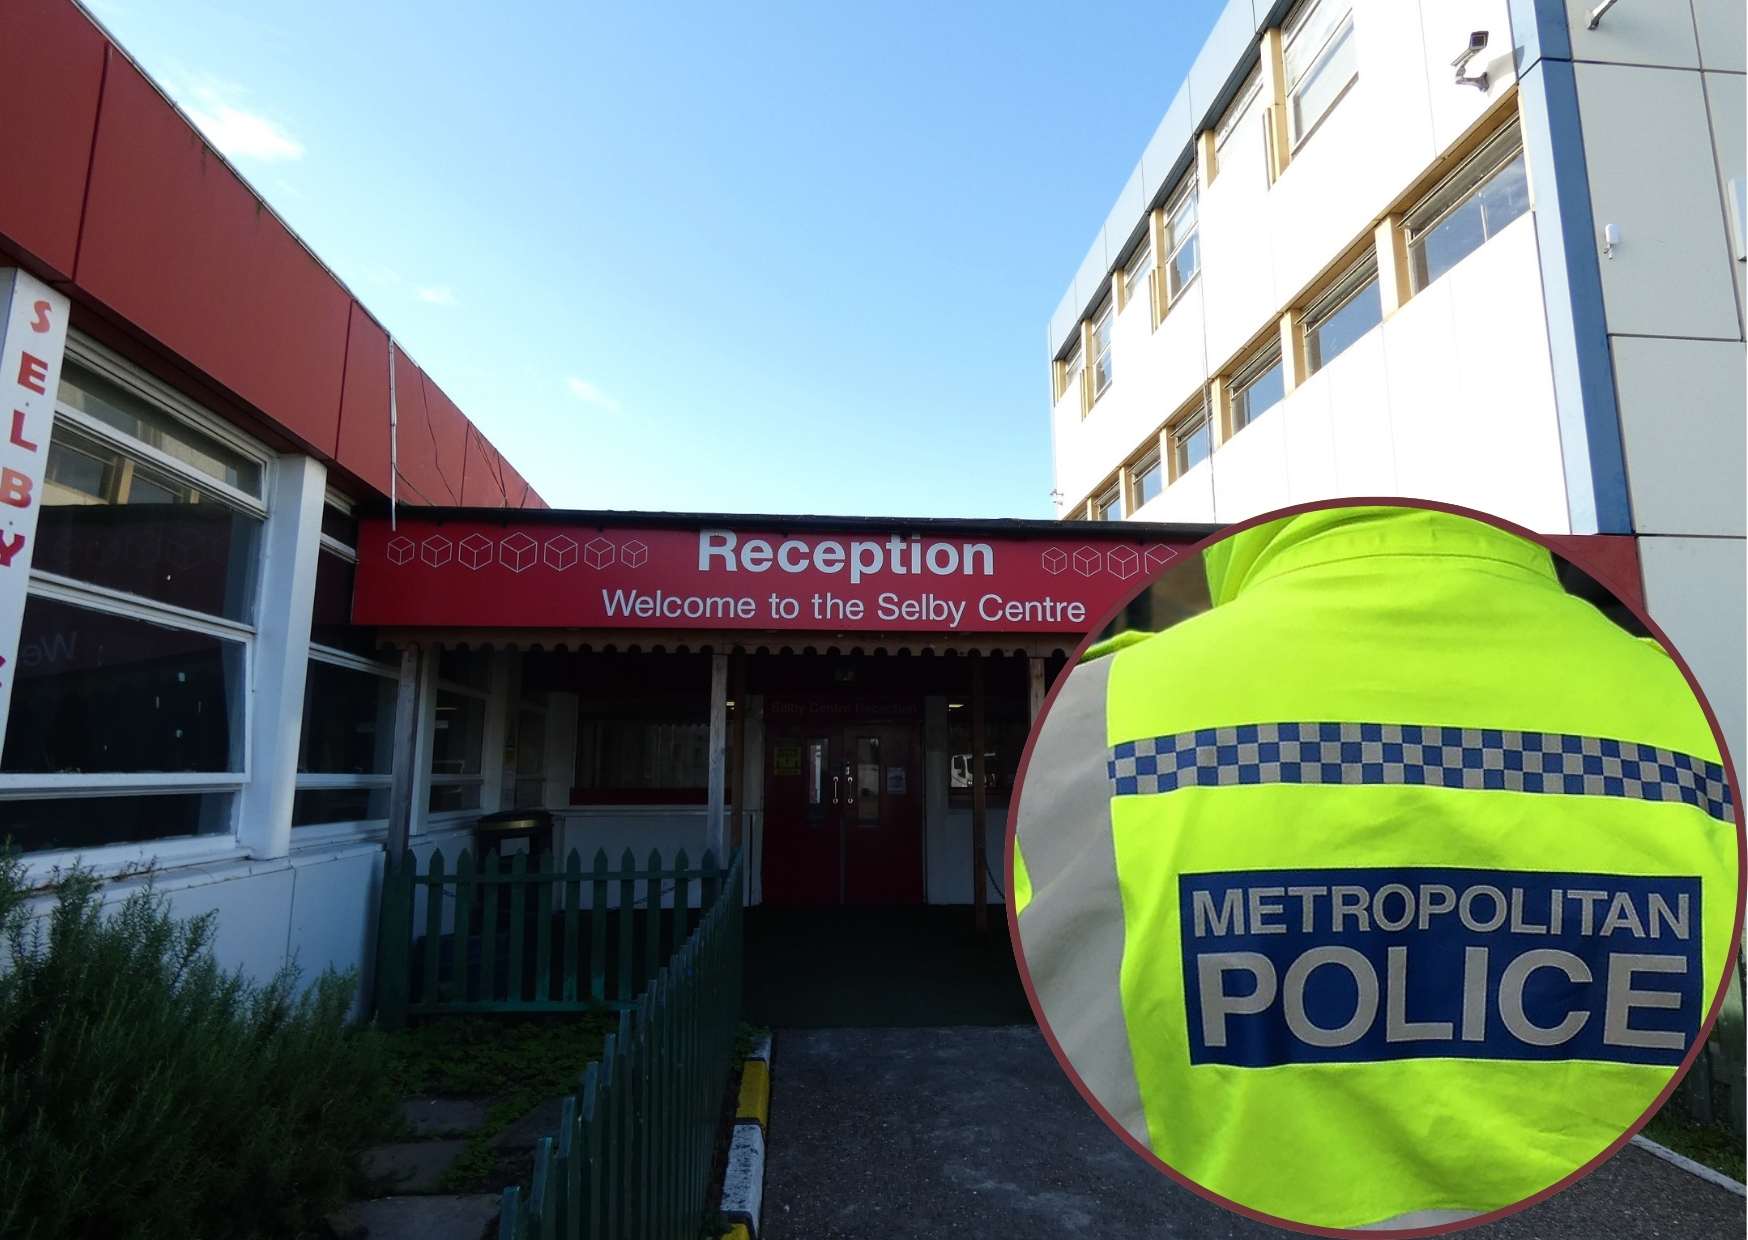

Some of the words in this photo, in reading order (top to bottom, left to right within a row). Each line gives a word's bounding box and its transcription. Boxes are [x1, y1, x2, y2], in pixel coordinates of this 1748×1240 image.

[0, 300, 52, 567] SELBY
[698, 530, 994, 584] Reception
[602, 588, 756, 620] Welcome
[768, 592, 800, 621] to
[811, 592, 865, 622] the
[877, 592, 966, 628] Selby
[978, 594, 1086, 624] Centre
[1193, 884, 1690, 939] METROPOLITAN
[1197, 945, 1688, 1050] POLICE
